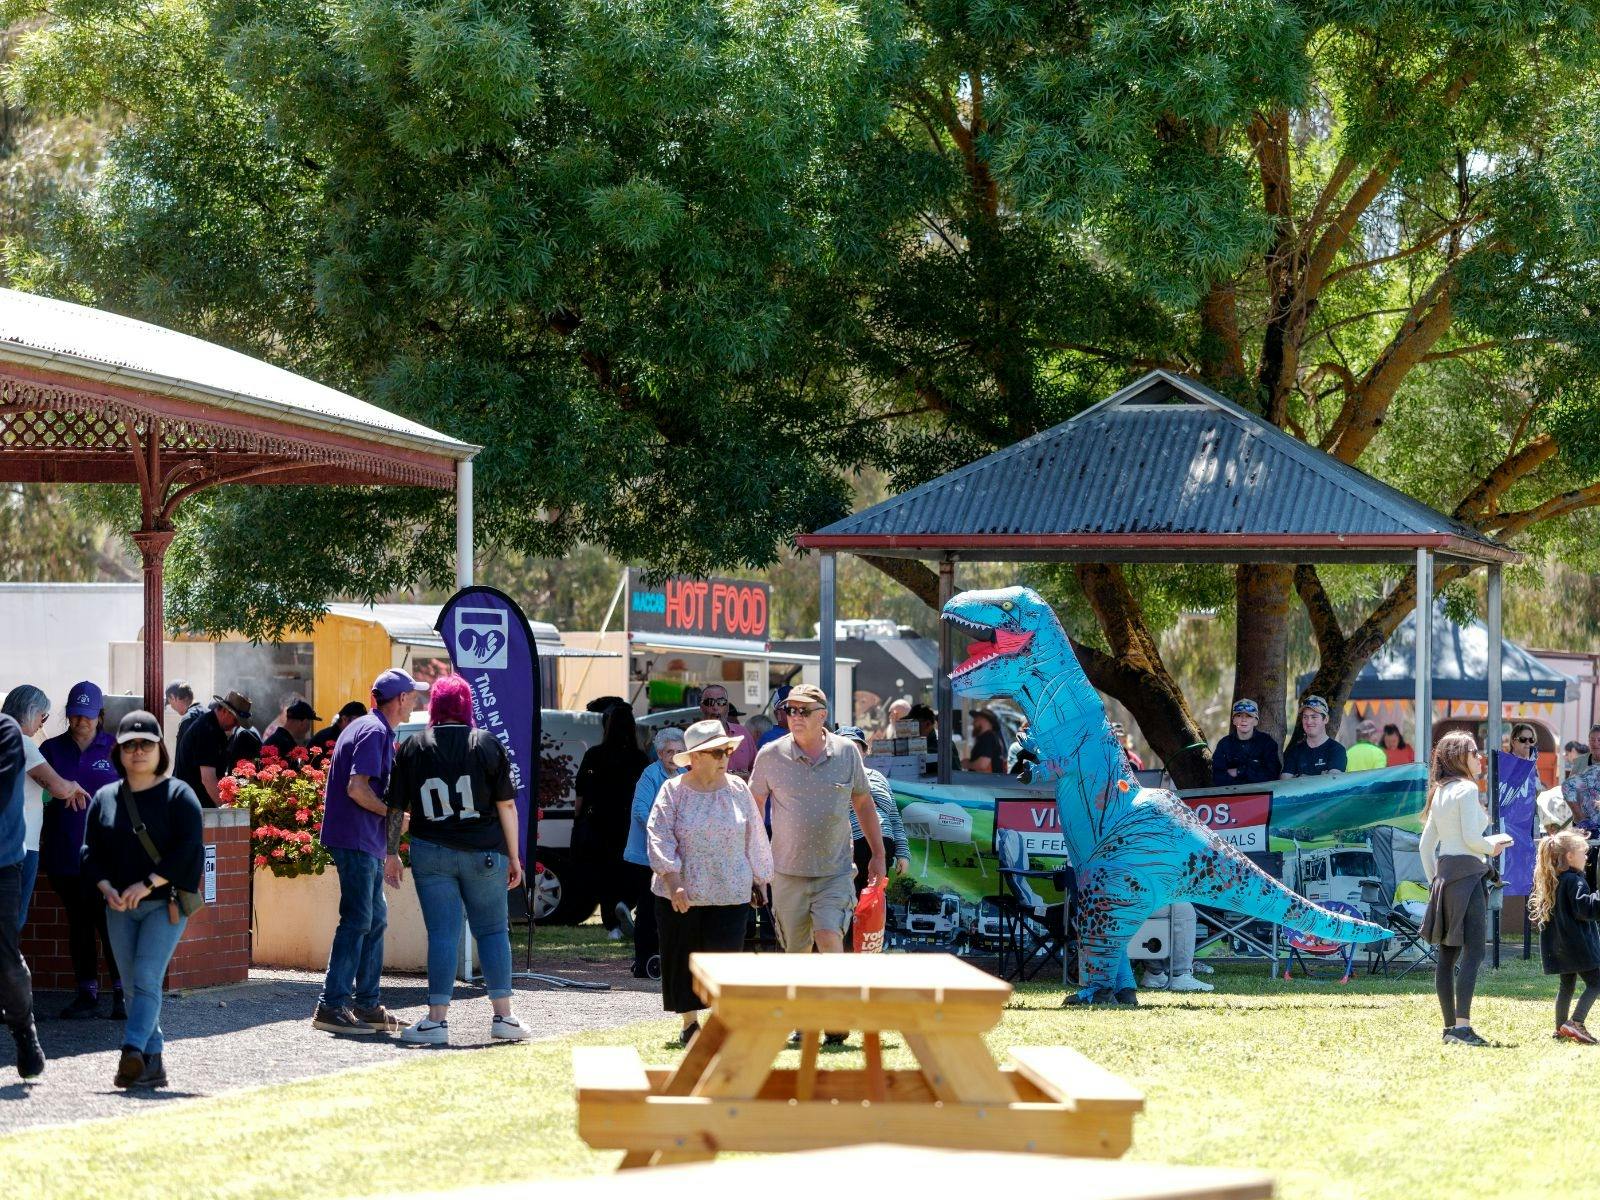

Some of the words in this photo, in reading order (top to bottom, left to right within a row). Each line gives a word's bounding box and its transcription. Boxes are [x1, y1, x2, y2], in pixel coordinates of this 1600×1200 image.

[666, 580, 708, 629] HOT
[712, 584, 766, 635] FOOD
[475, 672, 497, 707] TINS
[488, 710, 503, 727] IN
[420, 775, 480, 822] 01
